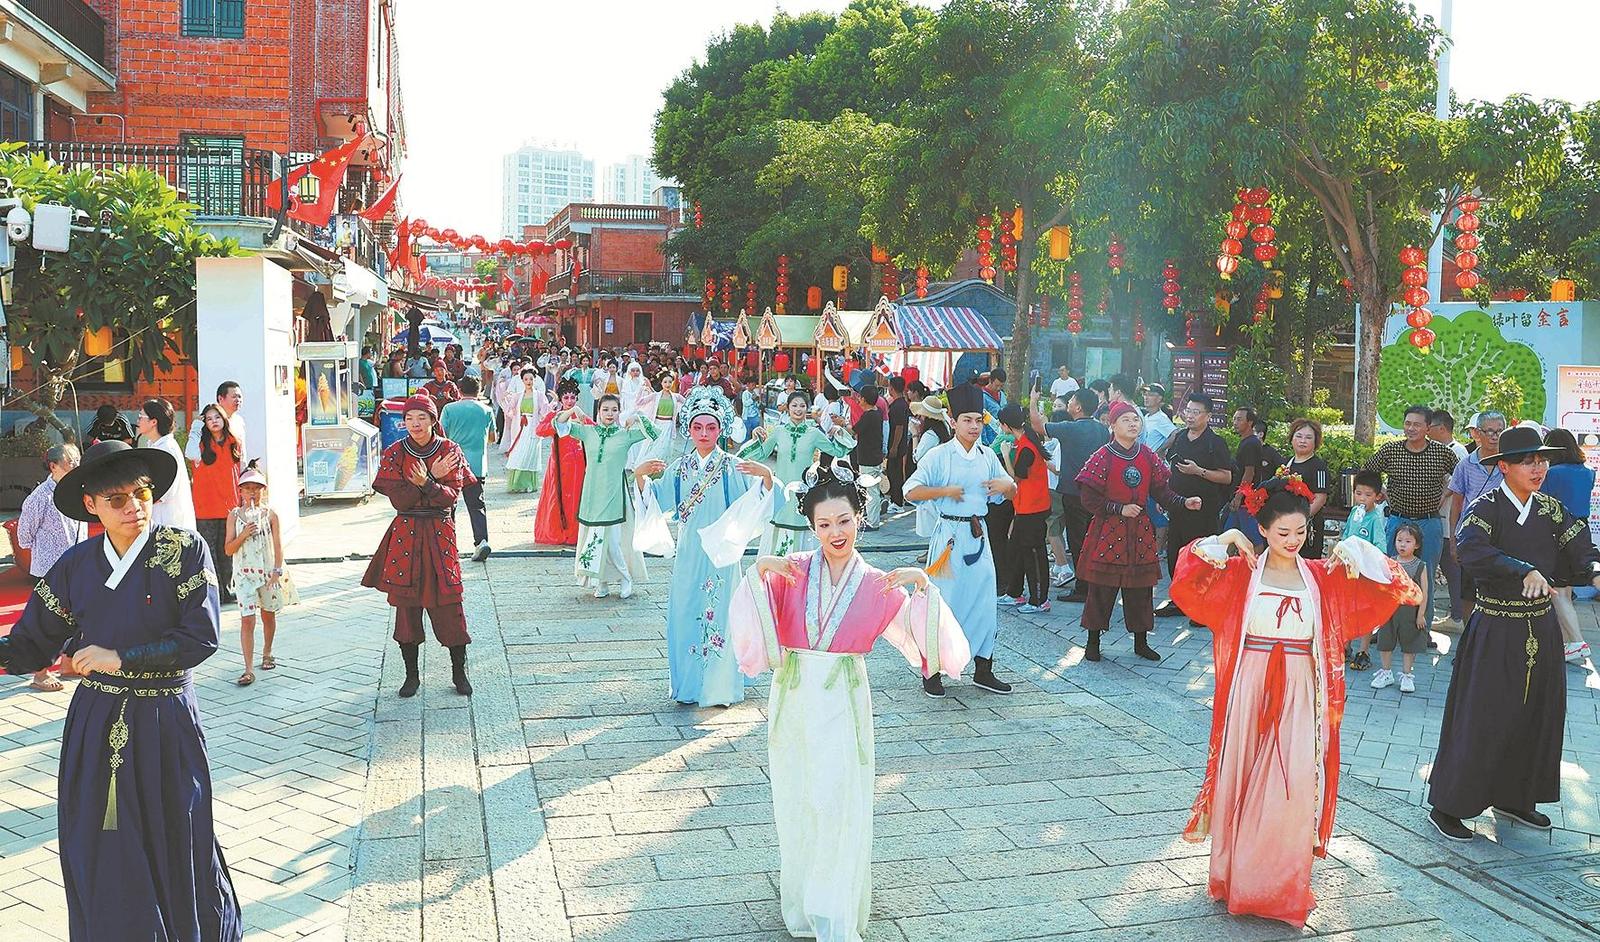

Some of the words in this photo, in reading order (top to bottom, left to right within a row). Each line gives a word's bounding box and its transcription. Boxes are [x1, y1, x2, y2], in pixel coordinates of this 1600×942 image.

[1492, 307, 1569, 328] 绿叶留金言
